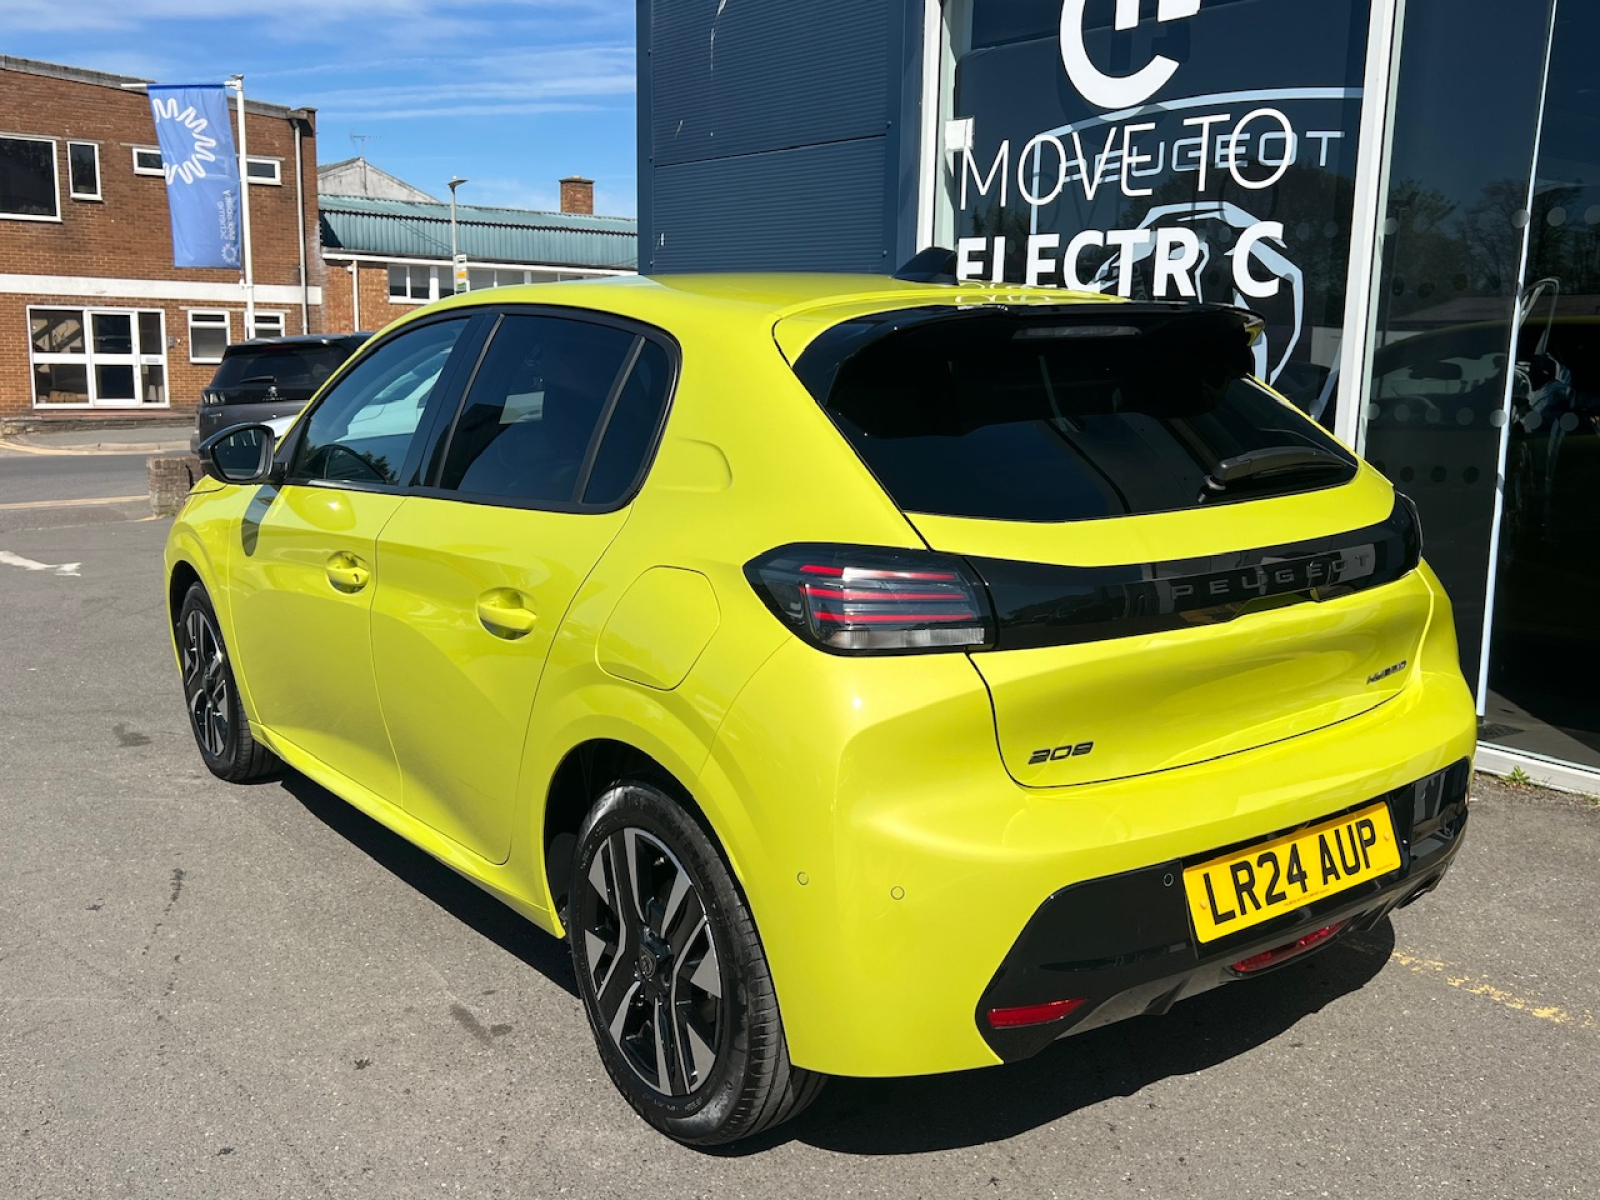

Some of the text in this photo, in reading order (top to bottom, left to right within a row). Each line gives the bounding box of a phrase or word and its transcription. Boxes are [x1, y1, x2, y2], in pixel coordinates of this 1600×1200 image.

[960, 108, 1294, 210] MOVE TO
[1059, 131, 1345, 193] PEUGEOT
[1171, 554, 1370, 600] PEUGEOT
[1028, 741, 1094, 765] 208
[1203, 818, 1377, 926] LR24 AUP
